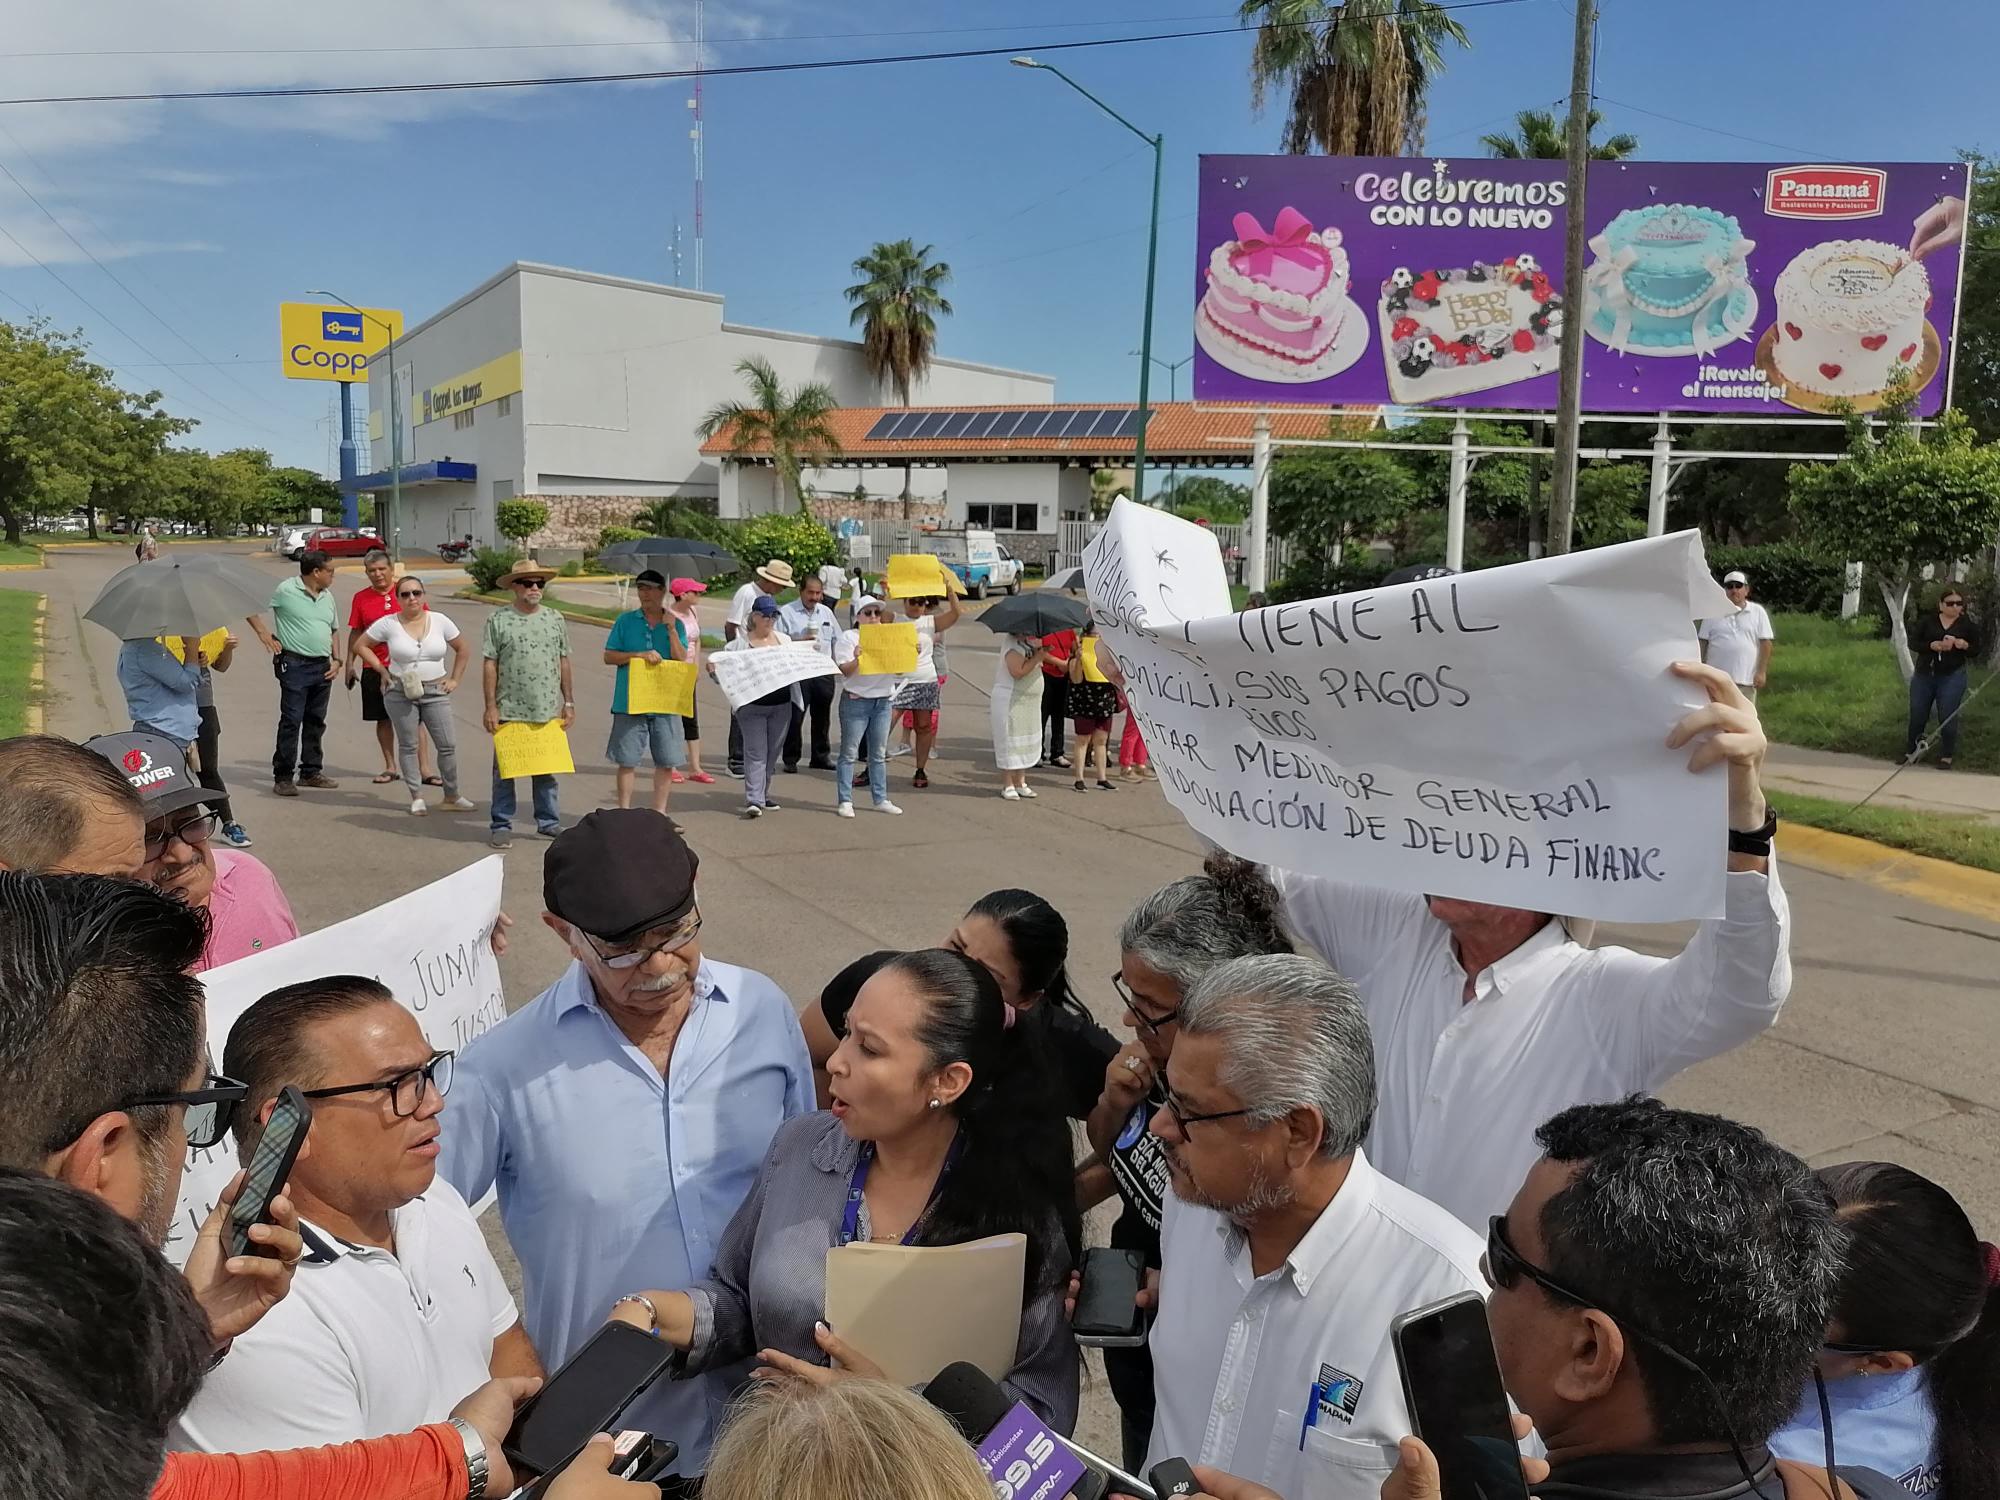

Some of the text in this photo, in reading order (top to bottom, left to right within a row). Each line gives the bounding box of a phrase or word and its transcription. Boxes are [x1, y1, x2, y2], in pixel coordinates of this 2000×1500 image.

[1354, 170, 1566, 207] Celebremos
[1780, 179, 1870, 198] Panamá
[1370, 206, 1553, 229] CON LO NUEVO
[1444, 289, 1508, 315] Happy
[1681, 381, 1787, 403] el mensaje!
[1409, 582, 1500, 633] AL
[1319, 664, 1470, 712] PAGOS
[1416, 777, 1611, 823] GENERAL
[1343, 805, 1387, 841] DE
[1401, 816, 1530, 870] DEUDA
[1129, 1148, 1147, 1175] DEL
[1137, 1136, 1155, 1163] DÍA
[1172, 1481, 1190, 1493] dji
